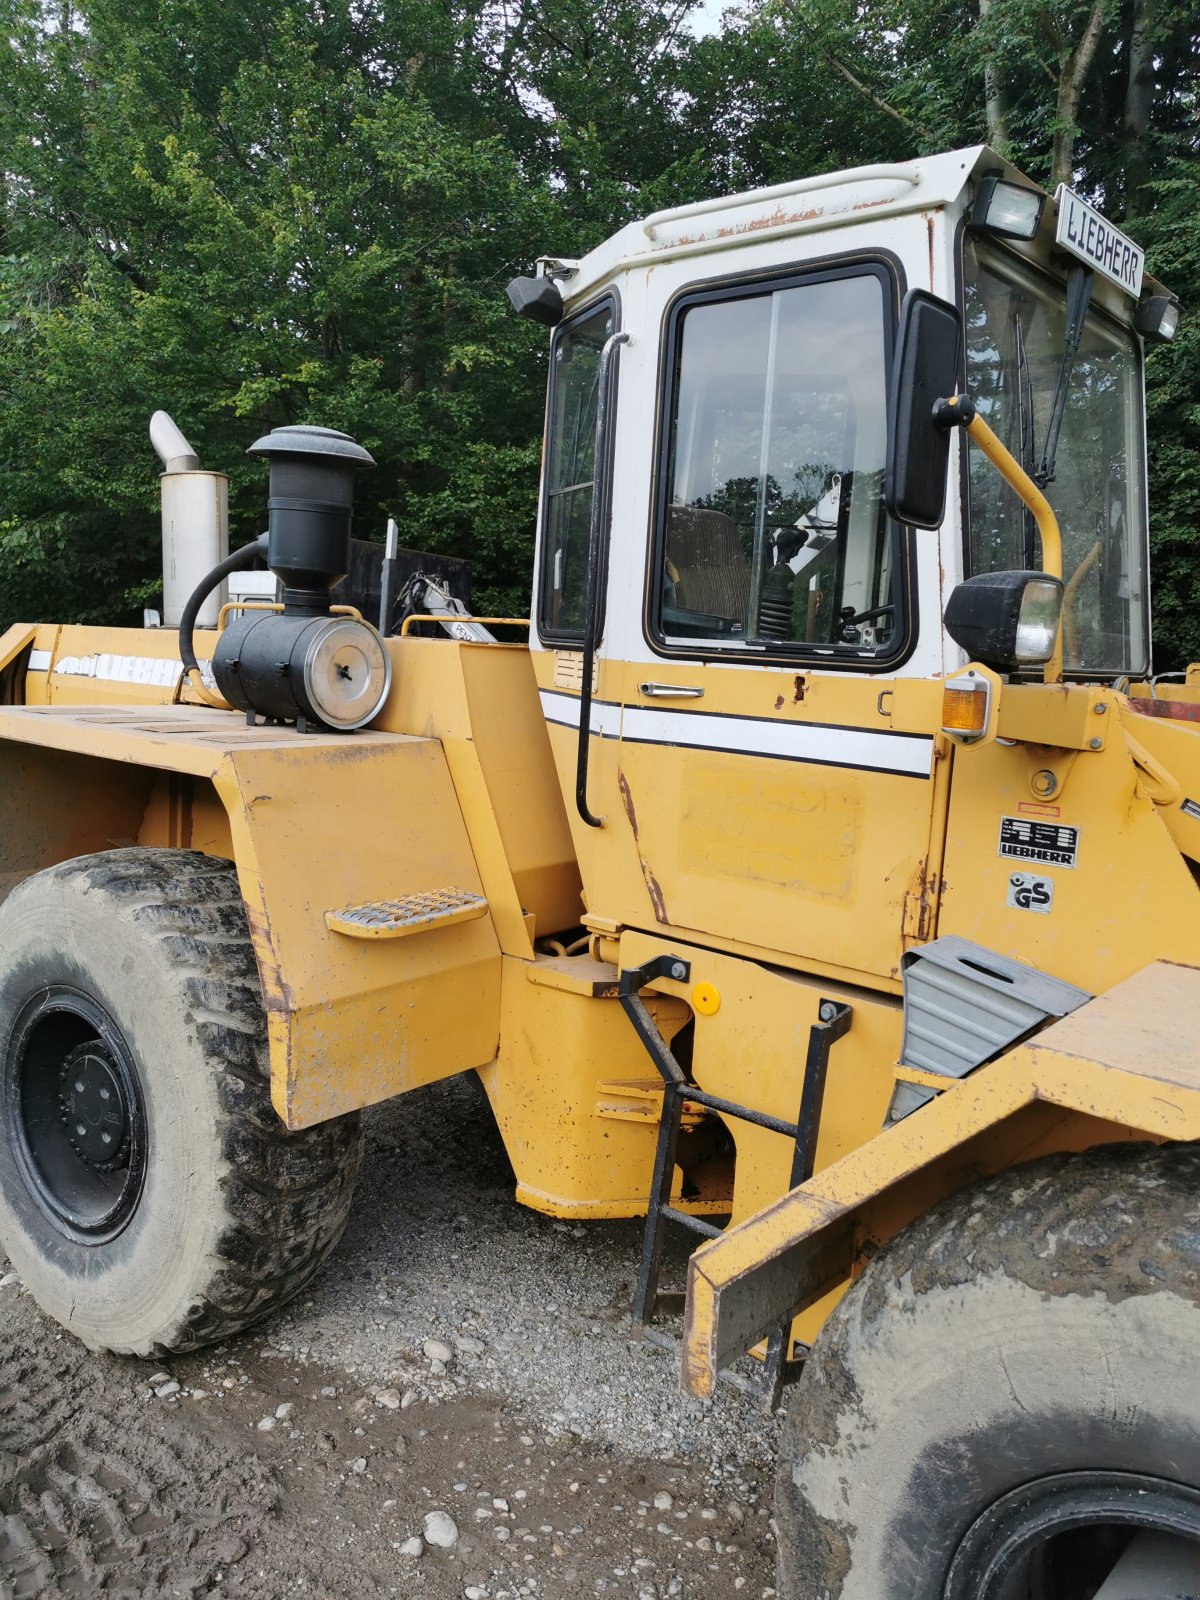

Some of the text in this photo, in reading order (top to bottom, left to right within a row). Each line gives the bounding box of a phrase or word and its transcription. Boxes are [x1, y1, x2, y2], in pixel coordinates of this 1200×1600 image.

[1067, 201, 1138, 288] LIEBHERR
[1001, 843, 1072, 864] LIEBHERR
[1014, 882, 1050, 908] GS
